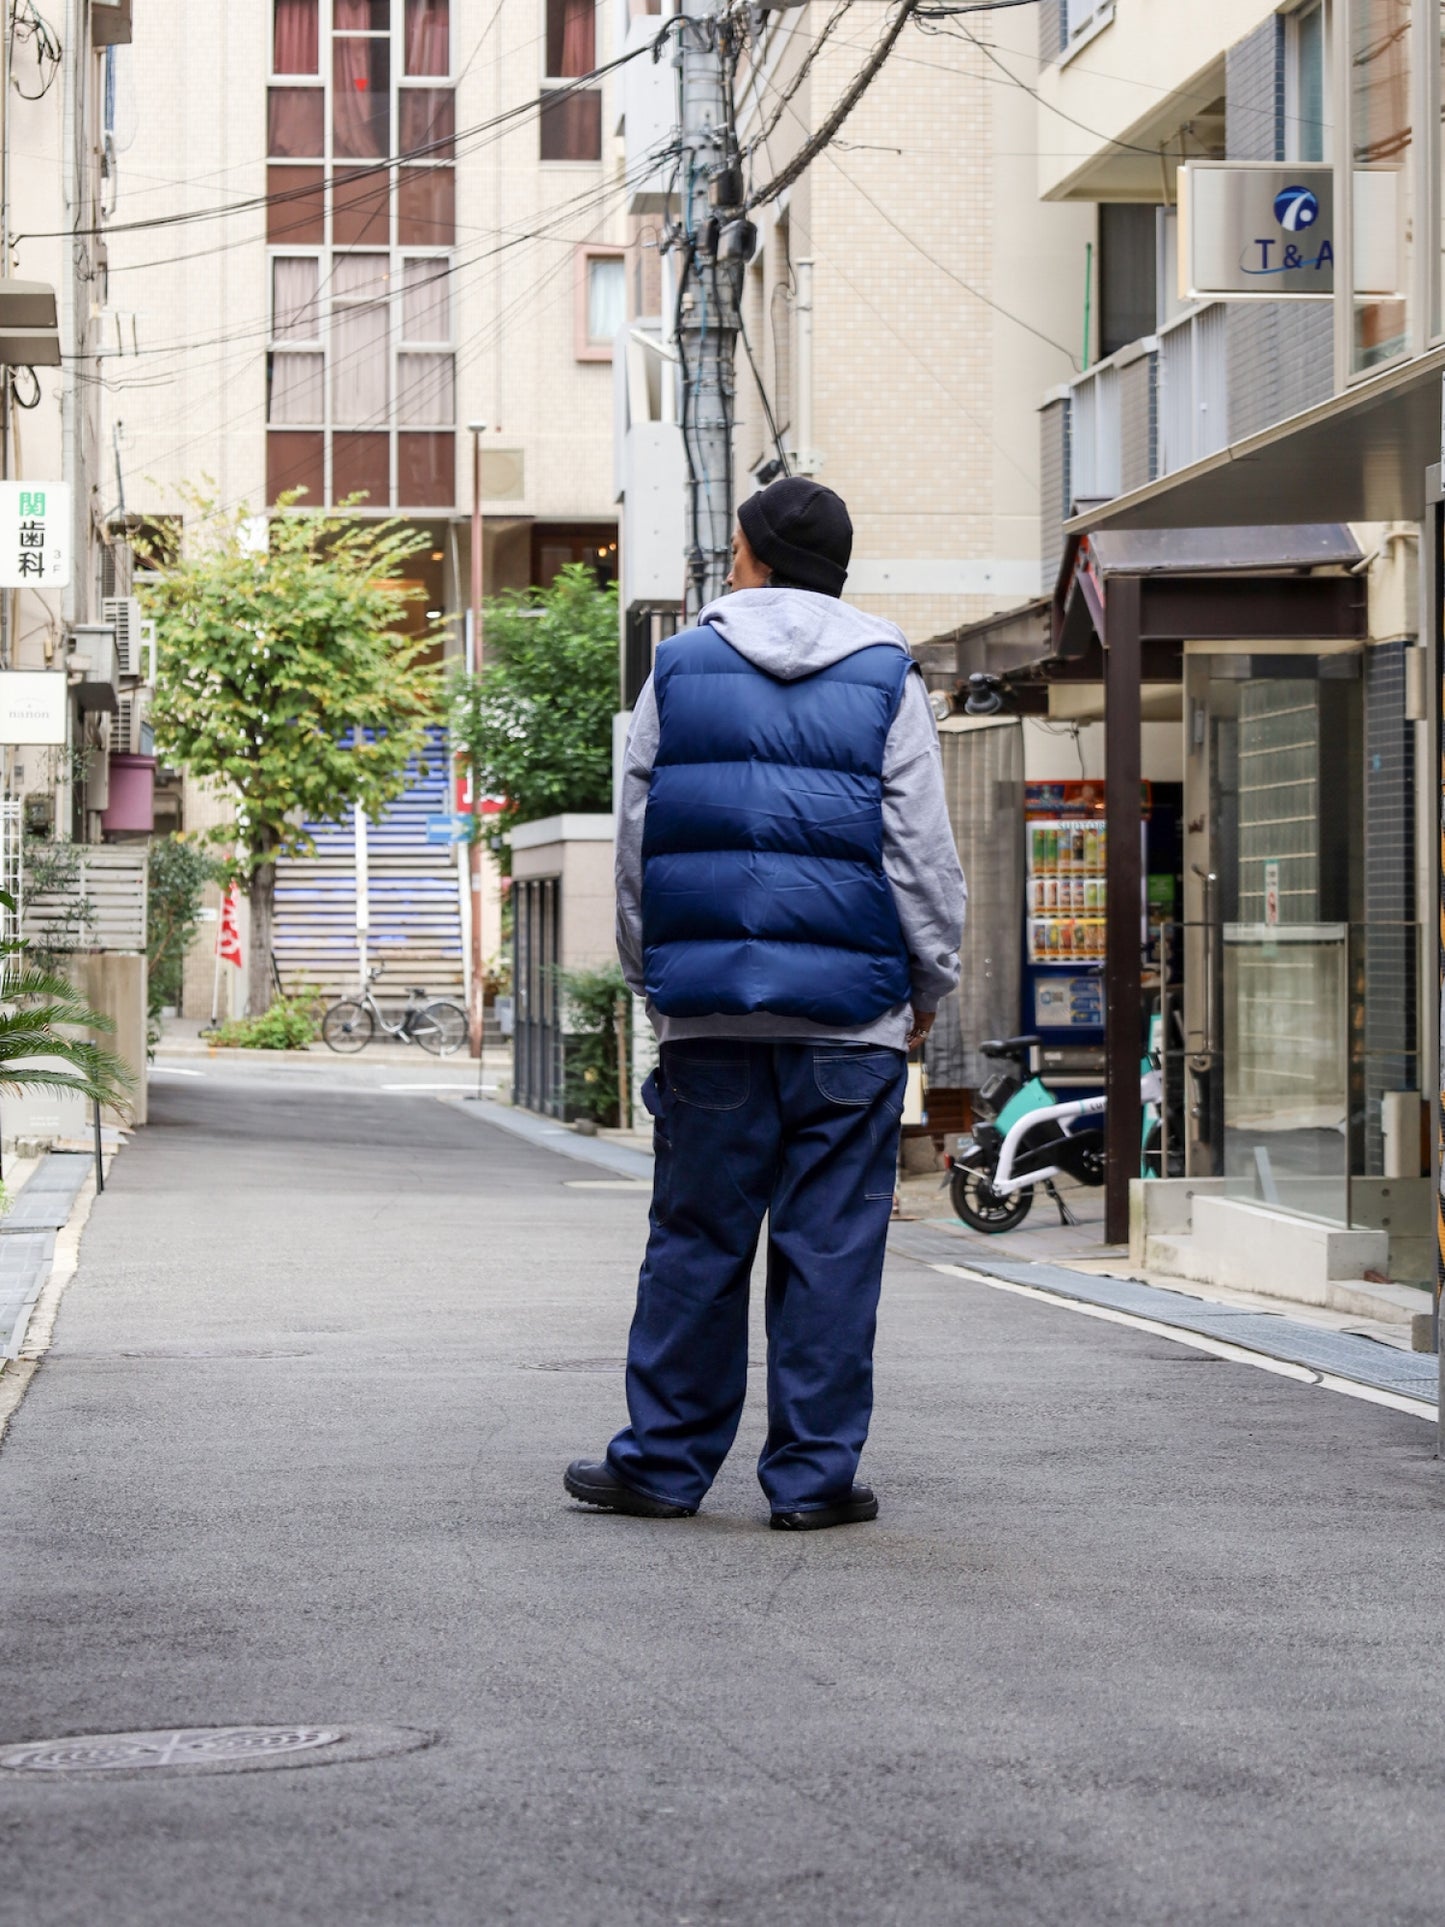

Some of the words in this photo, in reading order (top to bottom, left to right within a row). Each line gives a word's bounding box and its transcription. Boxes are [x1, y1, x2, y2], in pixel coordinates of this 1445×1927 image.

[1255, 239, 1275, 269] T
[1283, 244, 1303, 269] &
[19, 492, 46, 578] 関歯科
